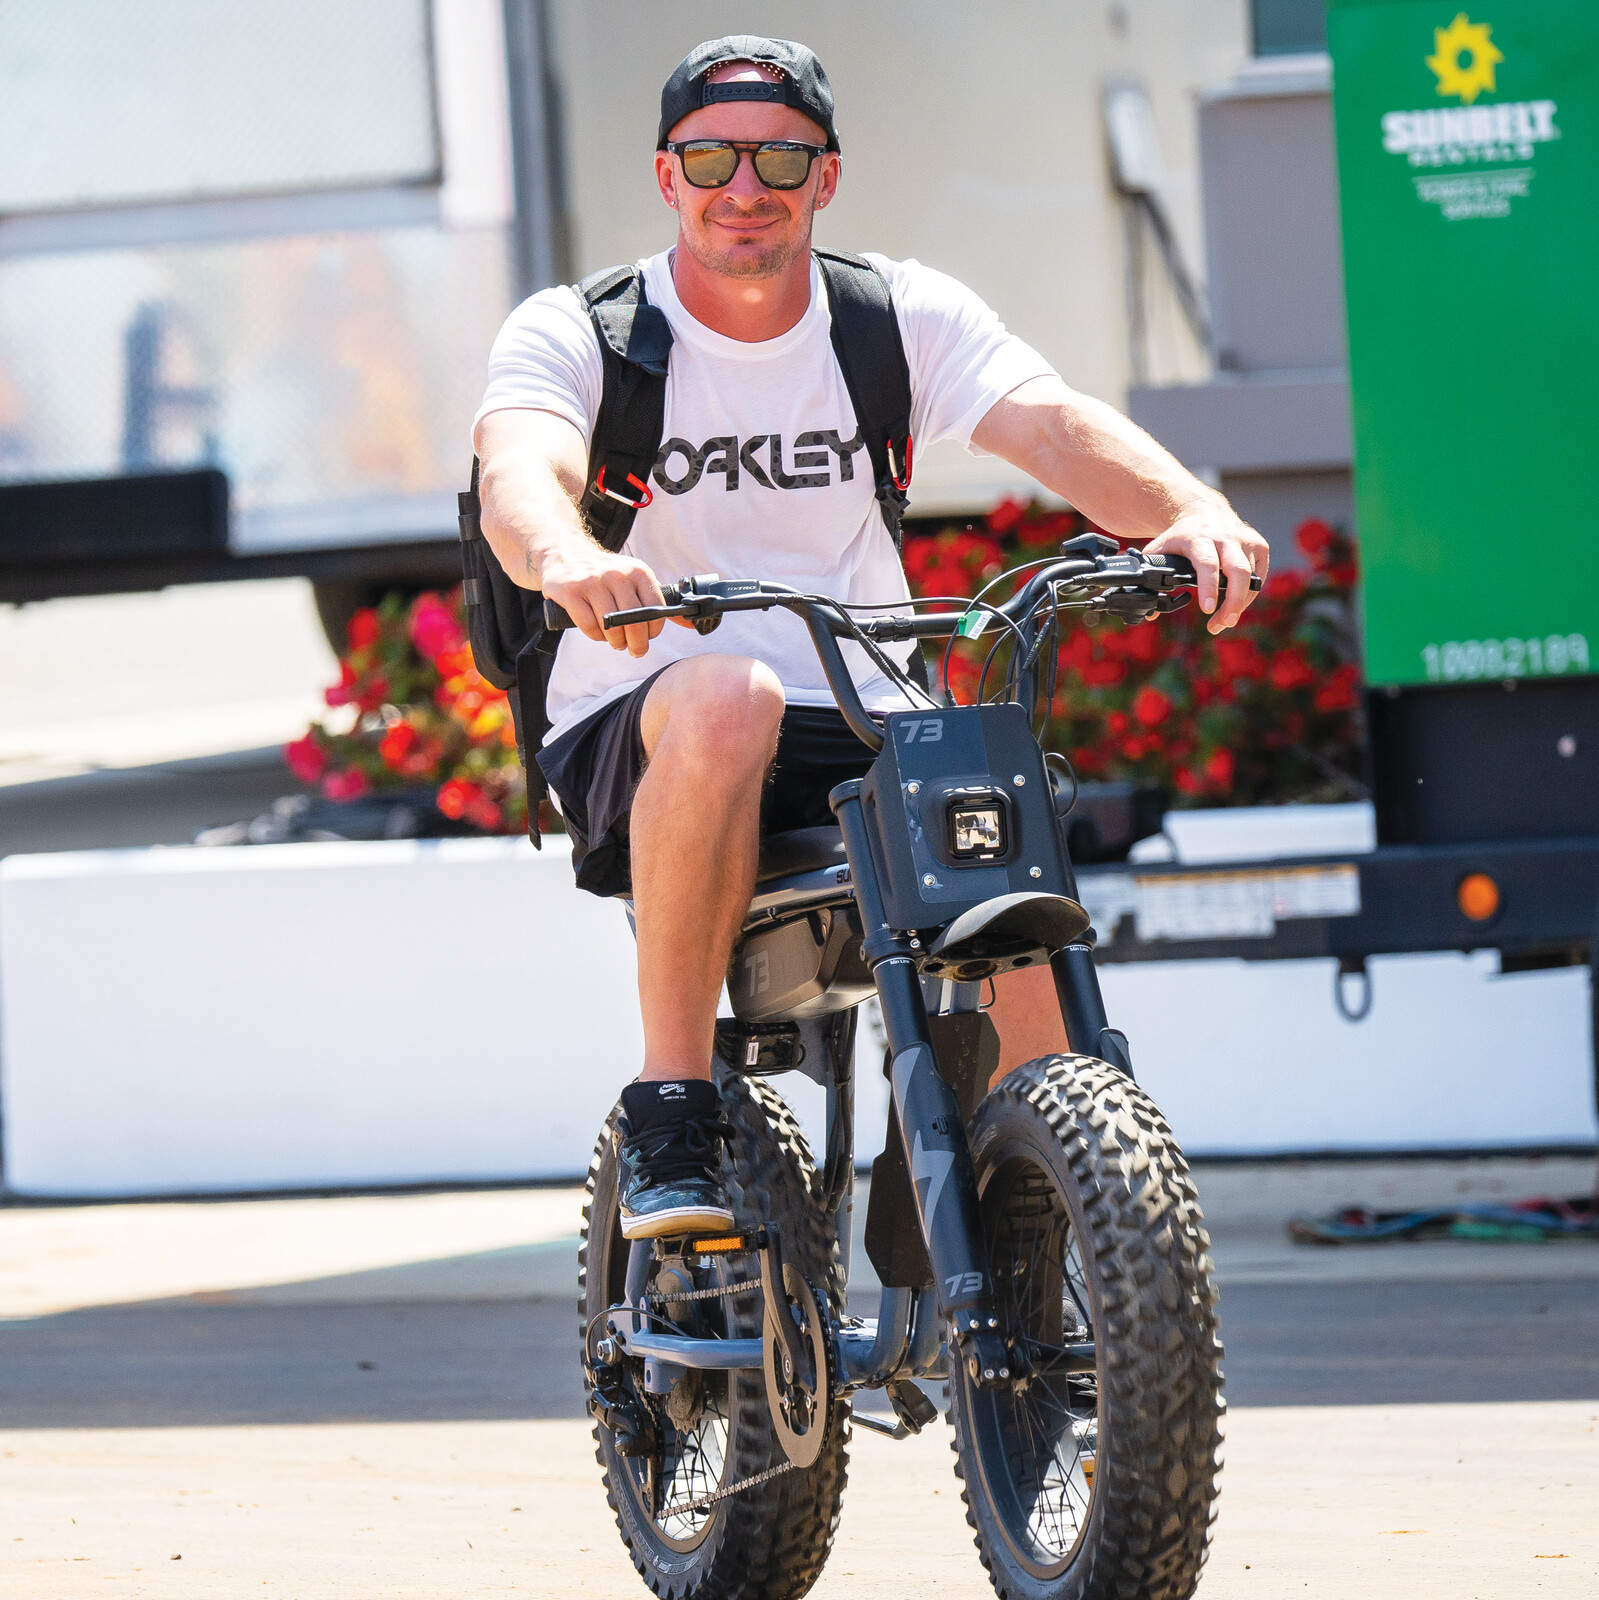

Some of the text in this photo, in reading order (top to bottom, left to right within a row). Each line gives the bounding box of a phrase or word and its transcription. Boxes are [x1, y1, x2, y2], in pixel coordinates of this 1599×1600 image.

[651, 426, 865, 495] OAKLEY
[900, 719, 943, 743] 73
[836, 868, 853, 884] SU
[945, 1271, 983, 1298] 73
